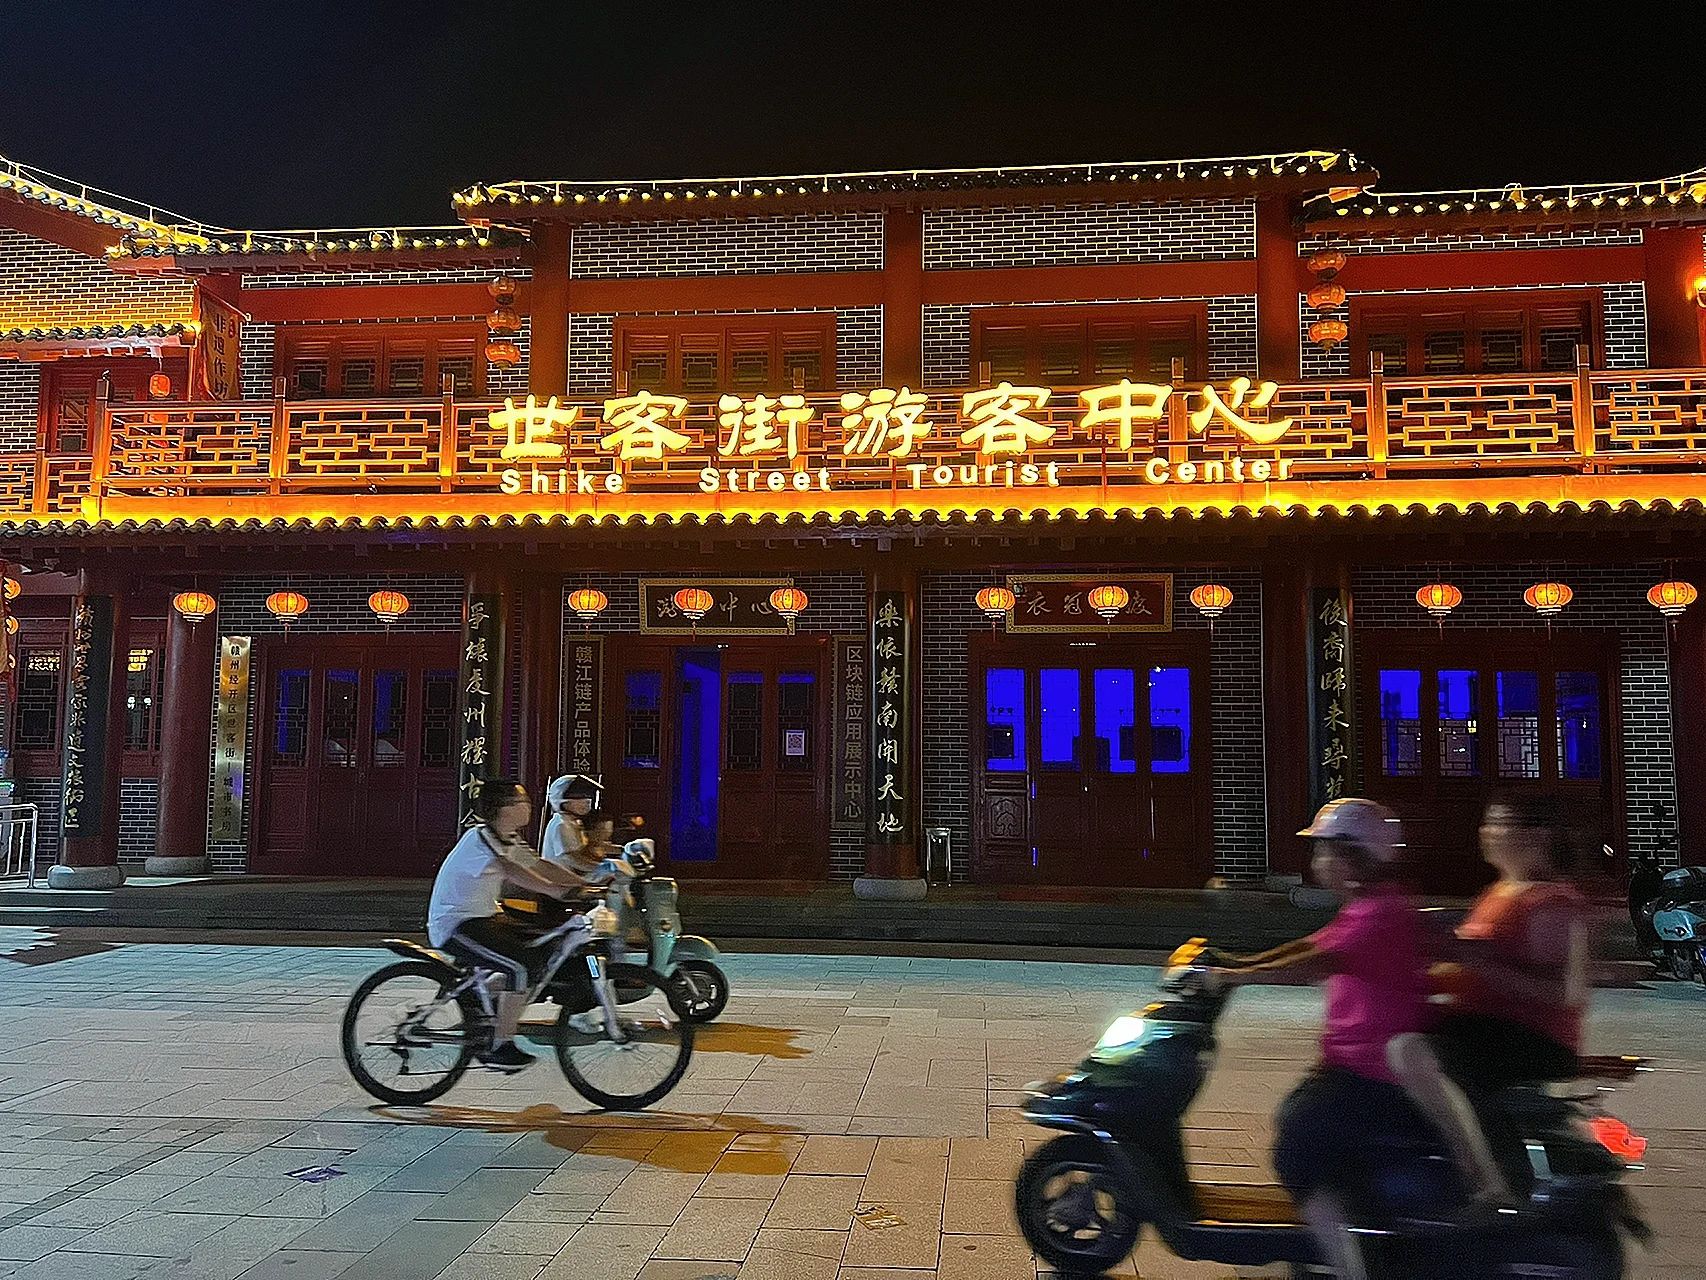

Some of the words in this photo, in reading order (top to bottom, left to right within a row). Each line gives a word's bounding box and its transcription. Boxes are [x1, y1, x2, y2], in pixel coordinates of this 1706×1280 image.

[488, 377, 1293, 460] 世客街游客中心
[500, 467, 624, 495] Shike
[698, 466, 833, 493] Street
[906, 460, 1061, 489] Tourist
[1145, 456, 1294, 485] Center
[844, 645, 865, 819] 区块链应用展示中心
